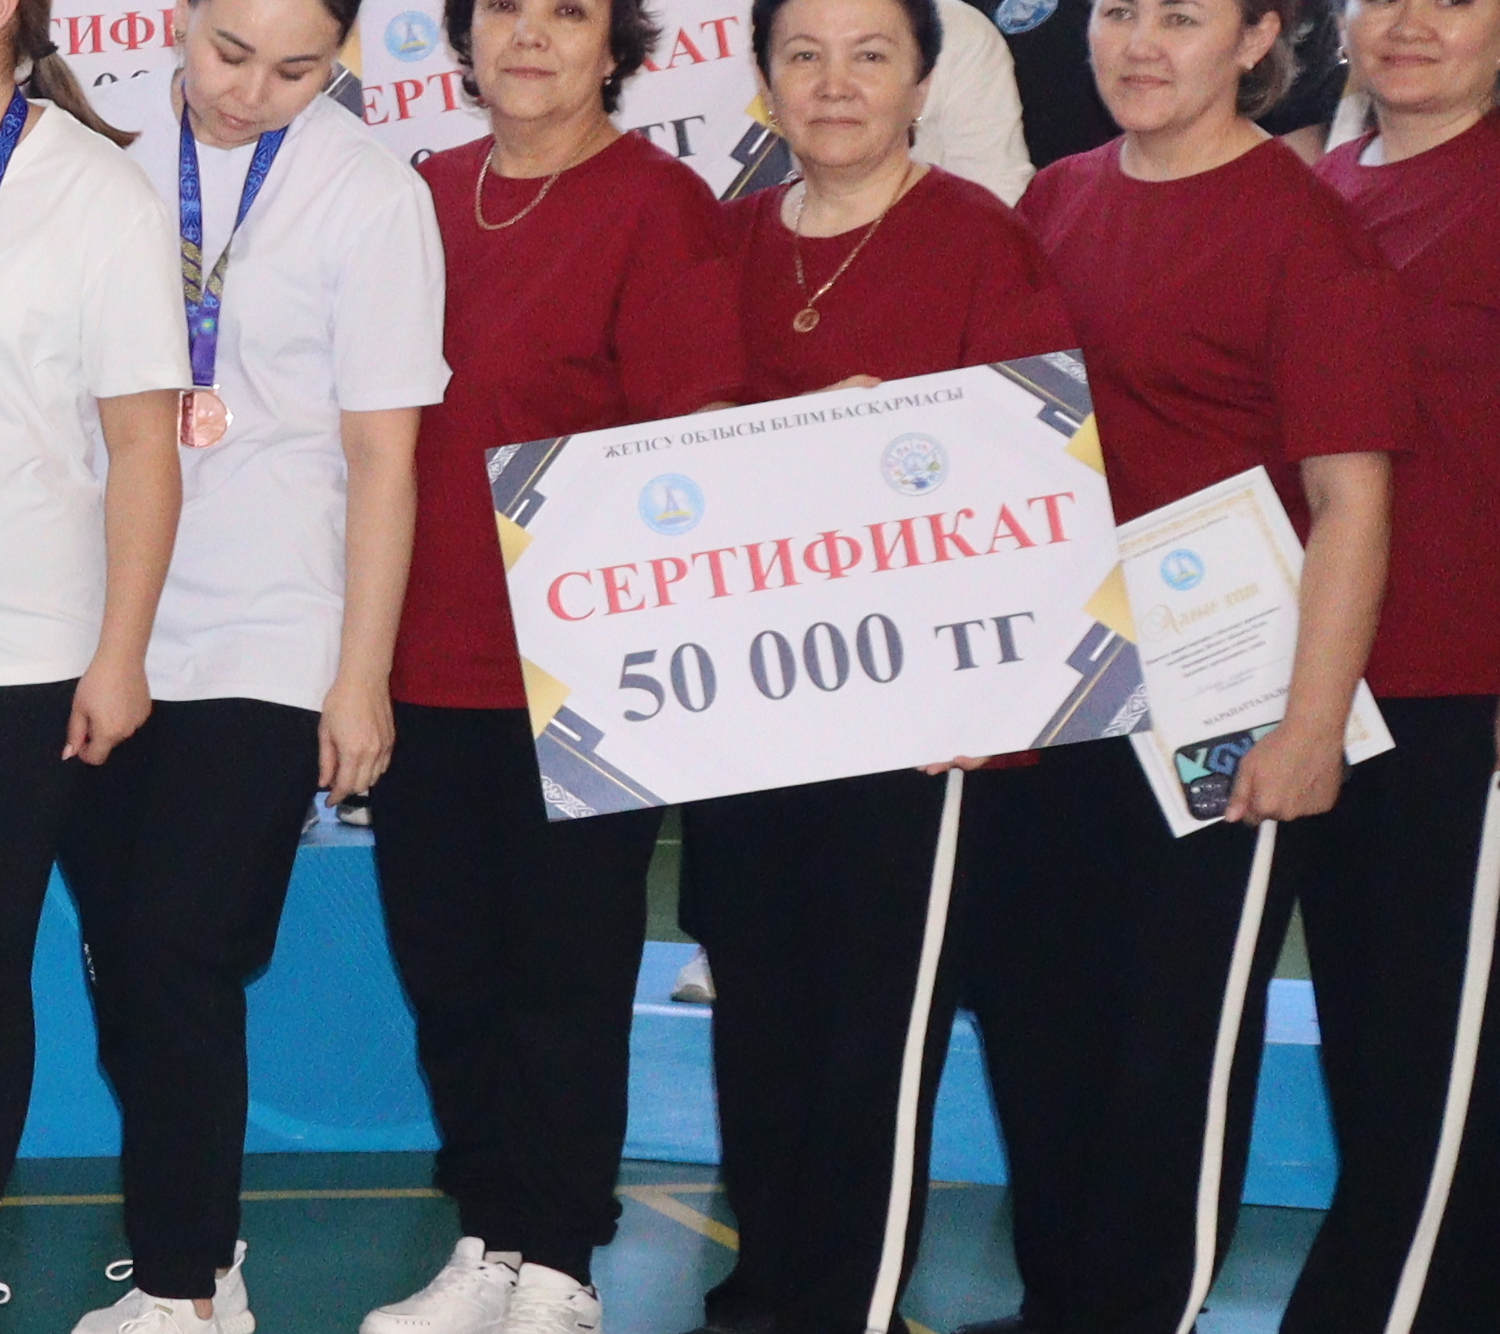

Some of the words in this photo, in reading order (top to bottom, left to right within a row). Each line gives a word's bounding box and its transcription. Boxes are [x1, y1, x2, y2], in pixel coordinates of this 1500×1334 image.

[603, 435, 675, 459] ЖЕТІСУ
[680, 420, 767, 446] ОБЛЫСЫ
[770, 409, 827, 432] БІЛІМ
[546, 491, 1077, 622] СЕРТИФИКАТ
[618, 641, 718, 722] 50
[748, 612, 905, 701] 000
